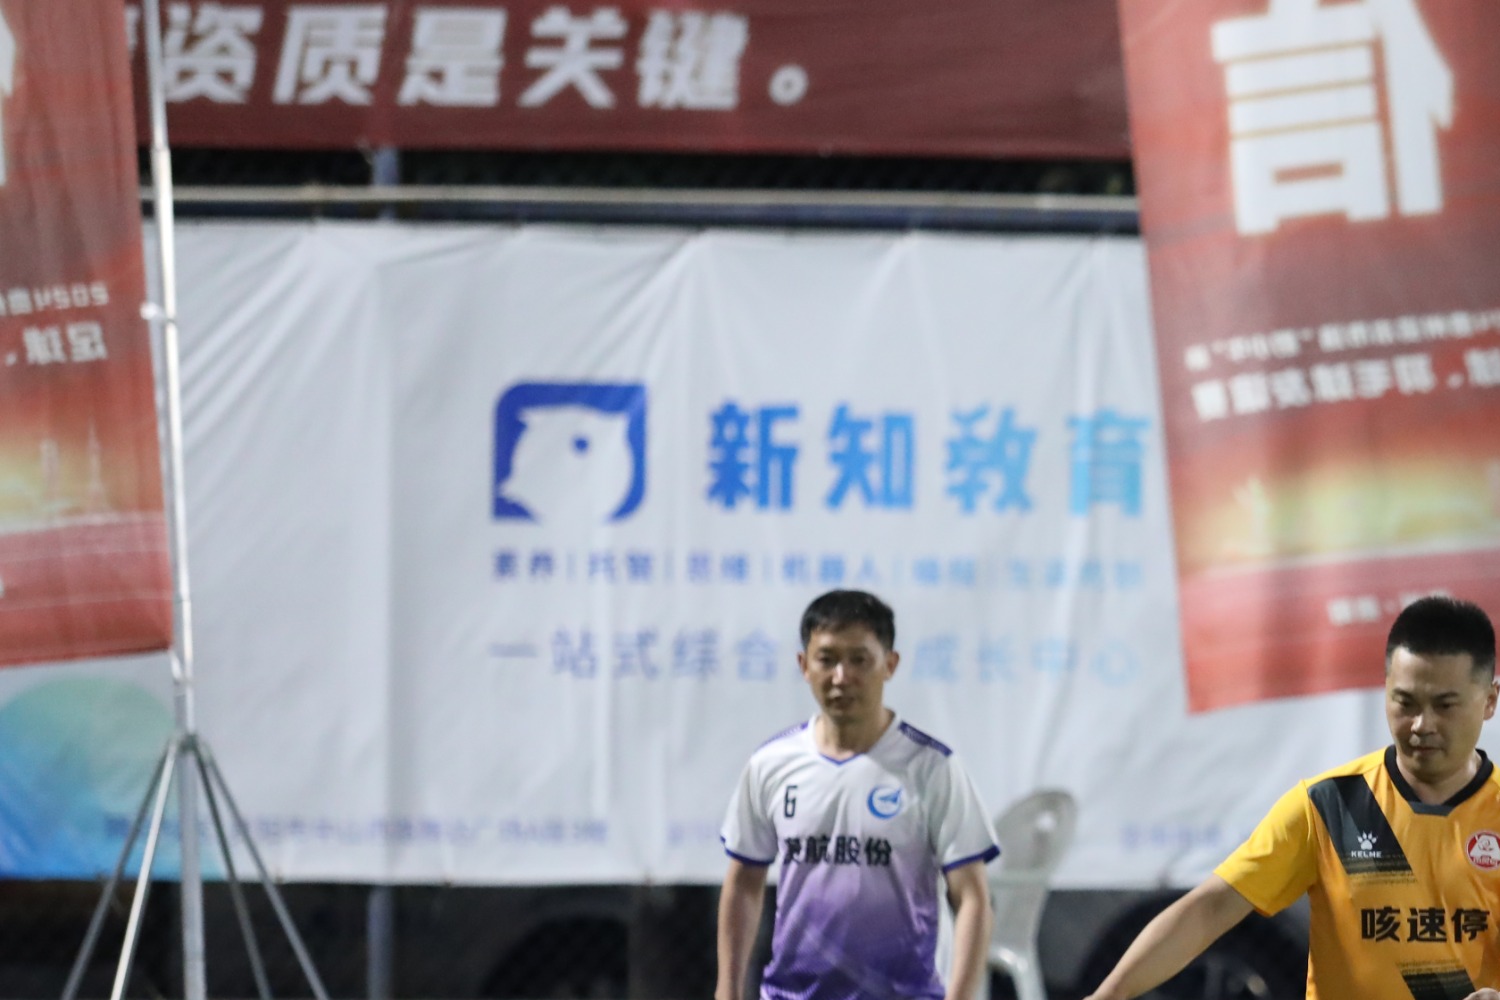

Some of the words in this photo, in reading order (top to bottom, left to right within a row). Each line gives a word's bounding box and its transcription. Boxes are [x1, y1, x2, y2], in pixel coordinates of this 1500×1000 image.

[126, 3, 809, 112] 资质是关键。
[1351, 851, 1382, 859] KELME
[1361, 905, 1490, 943] 咳速停
